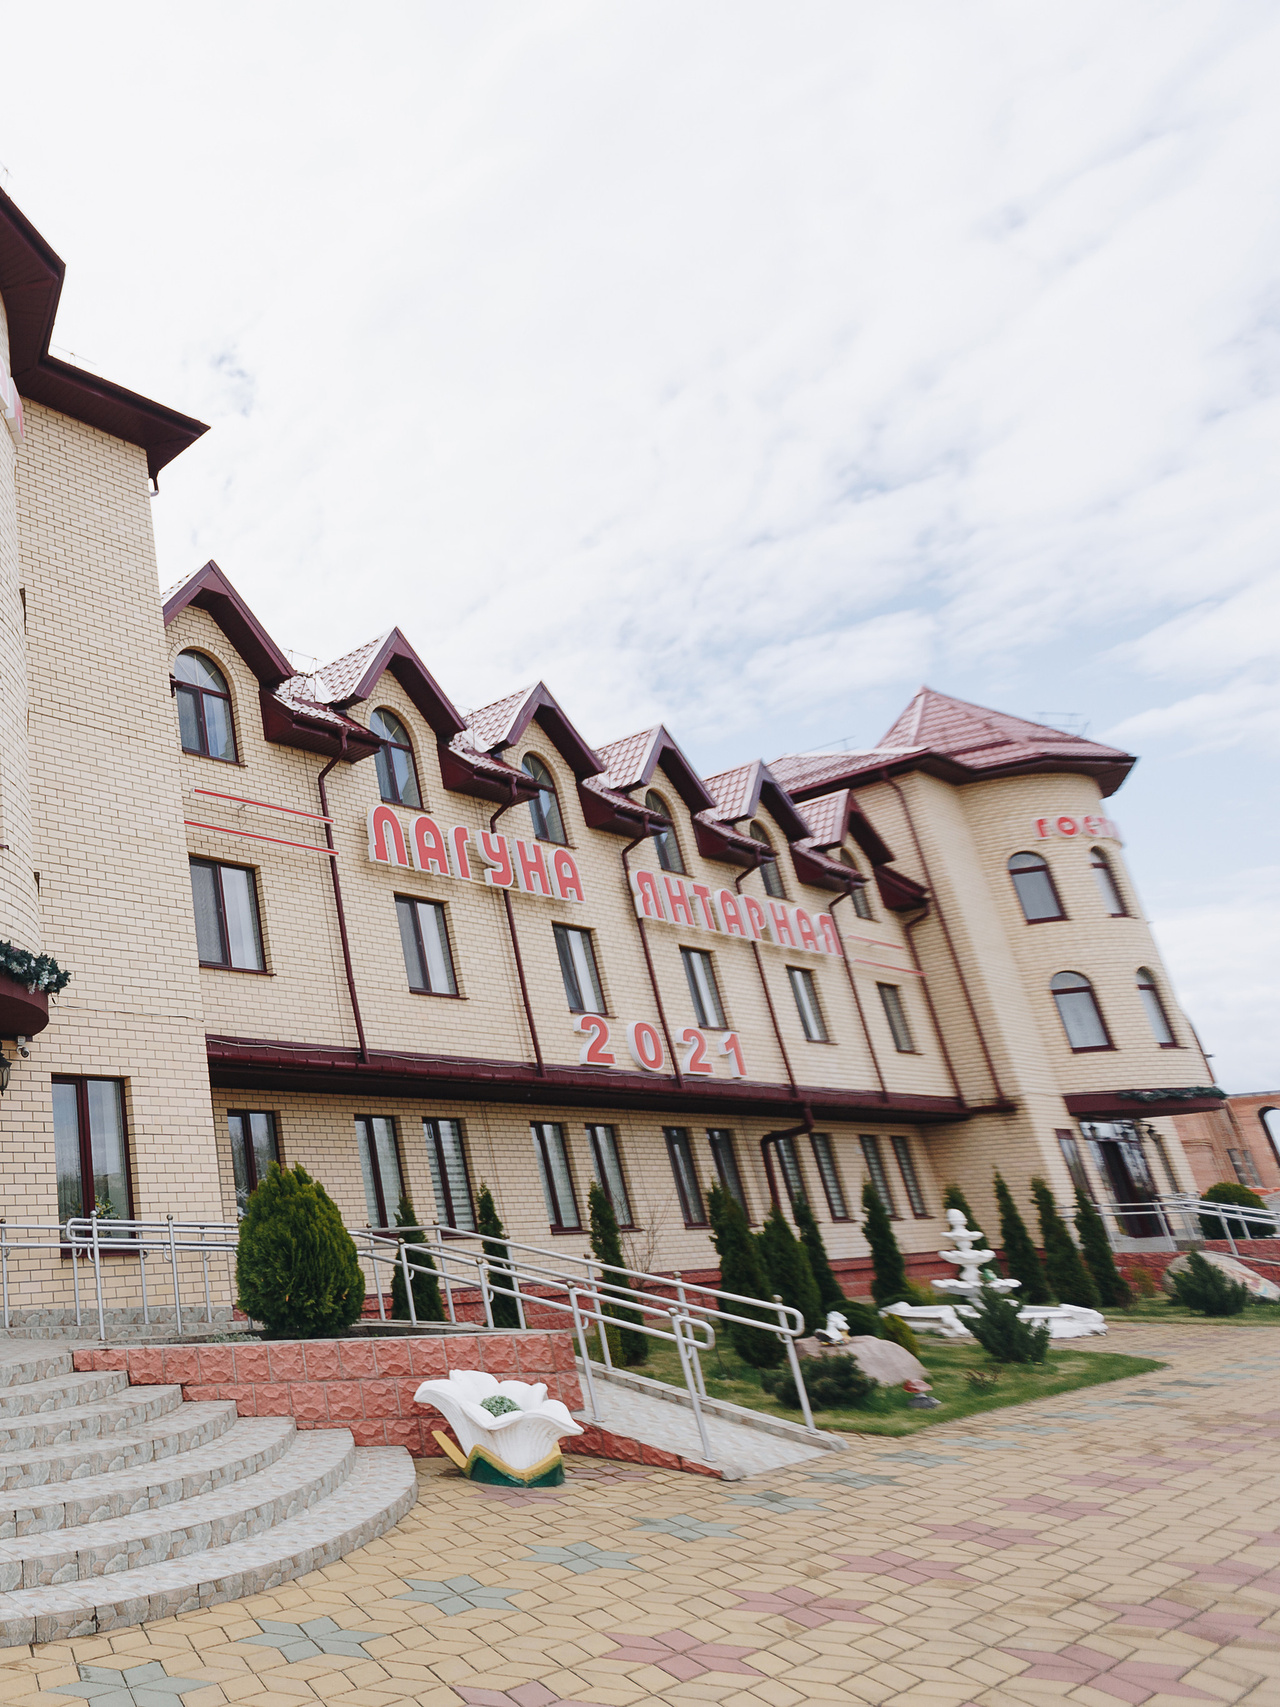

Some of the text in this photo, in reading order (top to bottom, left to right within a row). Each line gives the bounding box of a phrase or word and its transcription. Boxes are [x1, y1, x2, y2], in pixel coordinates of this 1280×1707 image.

[367, 804, 844, 957] ЛАГУНА ЯНТАРНАЯ
[572, 1013, 749, 1079] 2021
